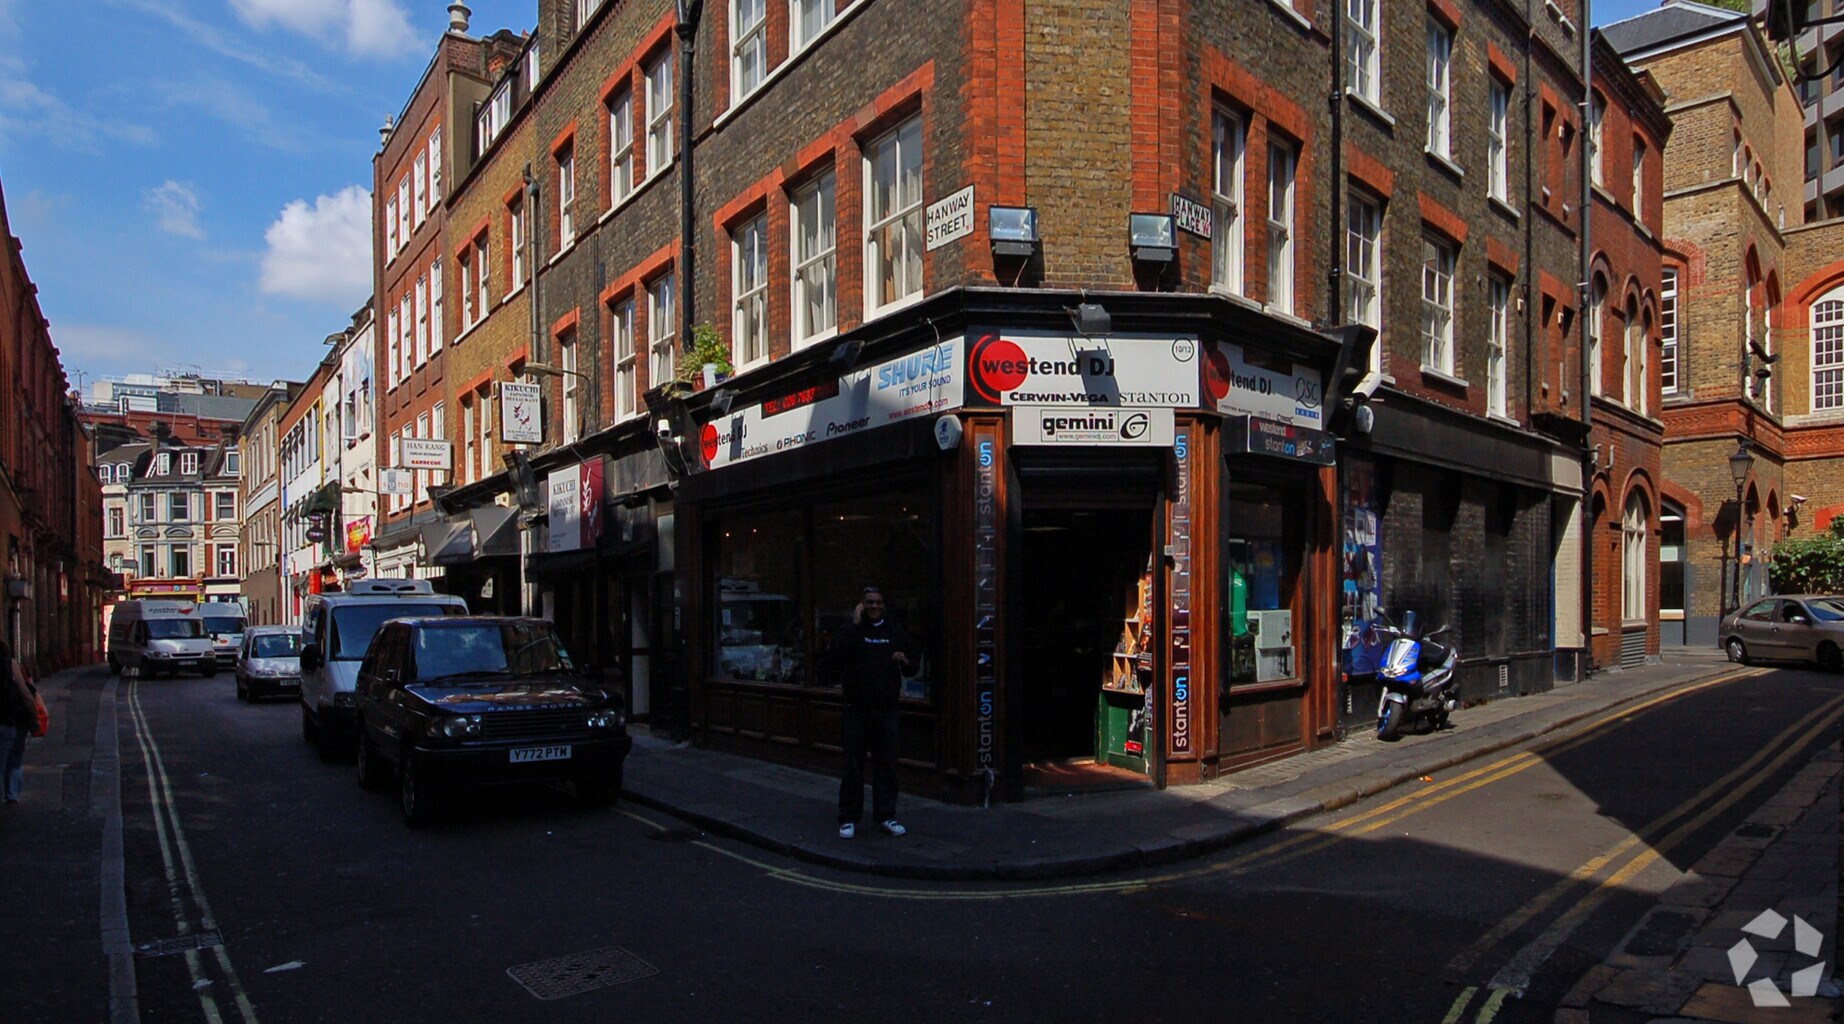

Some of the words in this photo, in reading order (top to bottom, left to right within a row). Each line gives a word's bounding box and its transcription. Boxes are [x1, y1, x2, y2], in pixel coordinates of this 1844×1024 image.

[927, 192, 970, 225] HANWAY
[1175, 195, 1210, 223] HANWAY
[927, 213, 967, 243] STREET
[1175, 210, 1201, 232] PLACE
[1174, 345, 1192, 355] 10/12
[878, 344, 953, 390] SHURE
[981, 356, 1081, 376] westend
[1089, 357, 1115, 377] DJ
[504, 384, 539, 393] KIKUCHI
[911, 381, 927, 394] YOUR
[929, 375, 951, 389] SOUND
[1259, 377, 1272, 396] DJ
[1295, 376, 1319, 408] QSC
[1009, 391, 1109, 403] CERWIN-VEGA
[737, 424, 747, 440] DJ
[826, 416, 871, 436] Pioneer
[1042, 413, 1114, 435] gemini
[1259, 421, 1286, 437] westend
[407, 442, 423, 450] HAN
[783, 431, 817, 448] PHONIC
[1265, 437, 1295, 455] stanton
[740, 442, 768, 459] Technics
[977, 441, 992, 514] stanton
[1173, 675, 1187, 747] stanton
[977, 691, 992, 763] stanton
[514, 748, 543, 761] Y772
[546, 746, 567, 758] PTM
